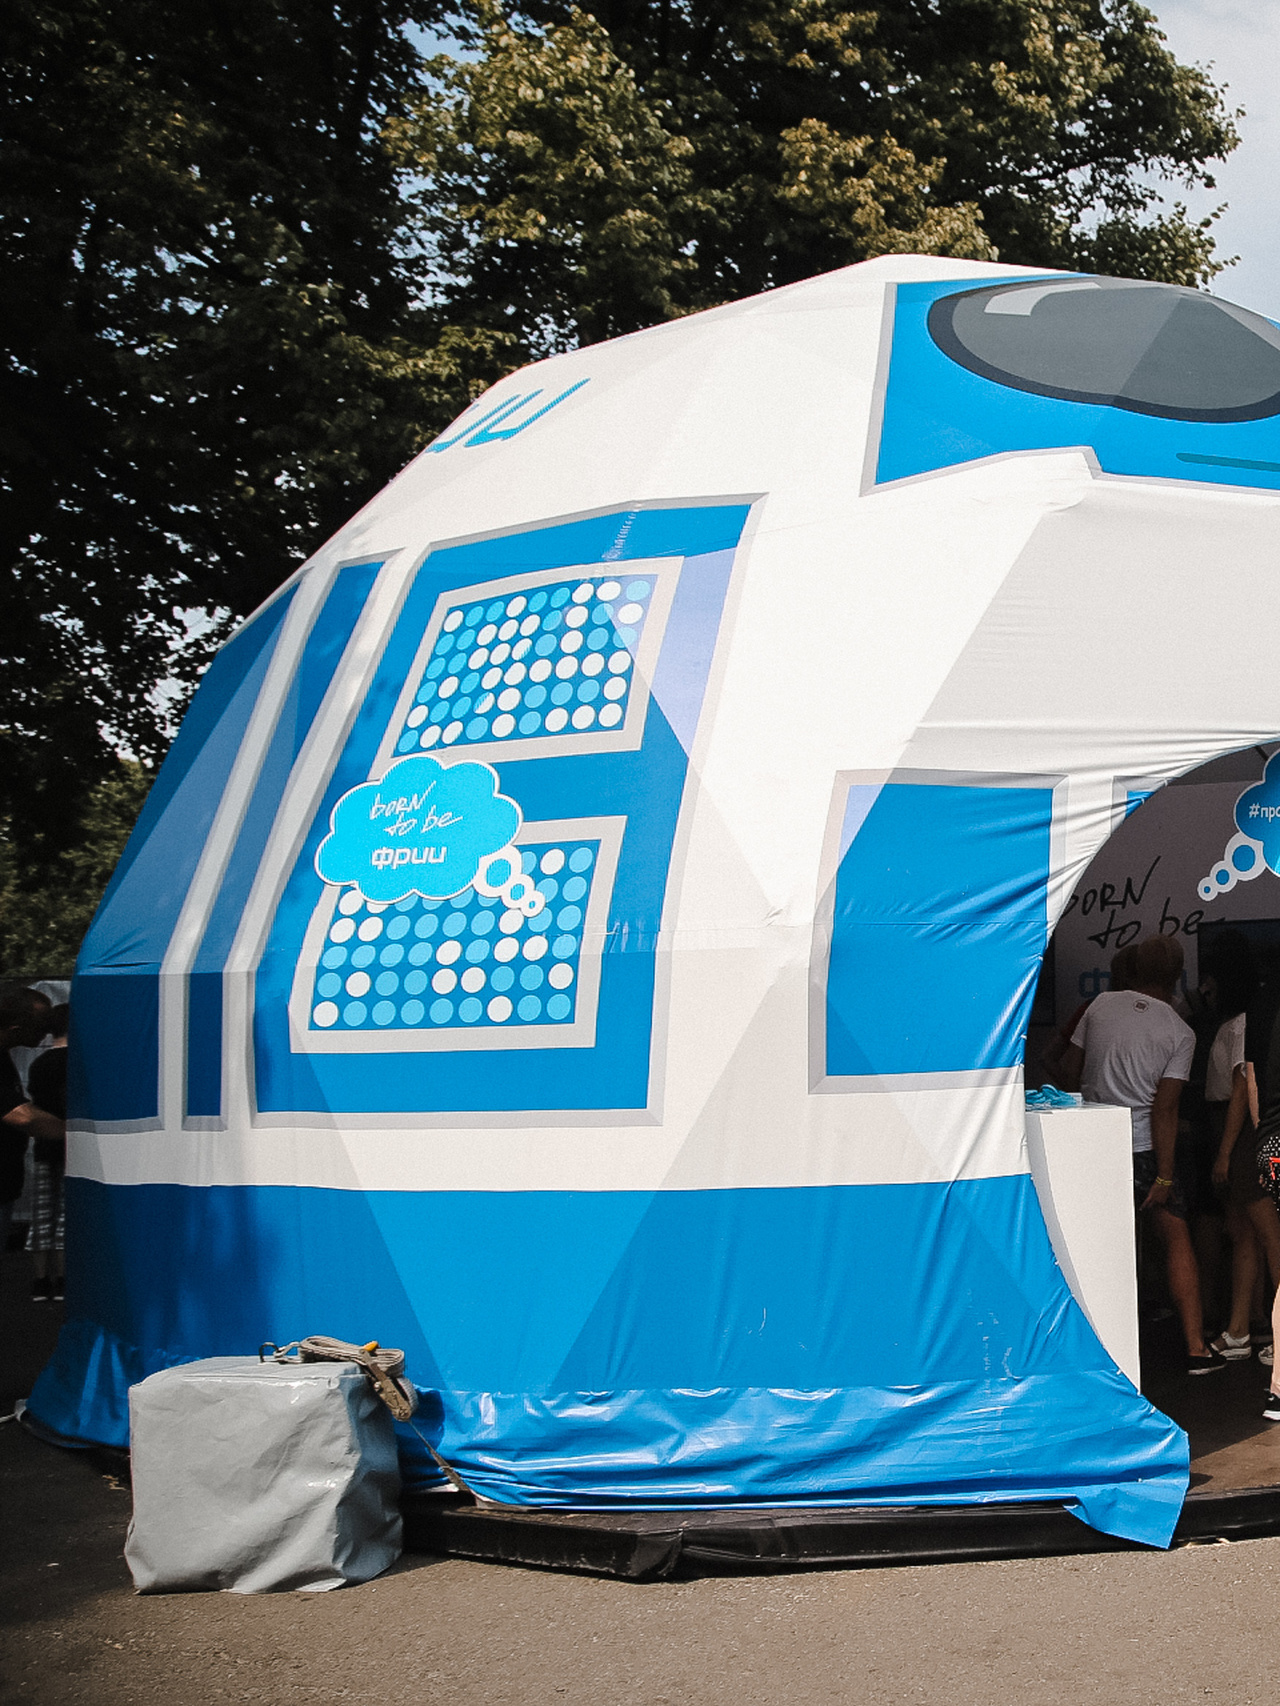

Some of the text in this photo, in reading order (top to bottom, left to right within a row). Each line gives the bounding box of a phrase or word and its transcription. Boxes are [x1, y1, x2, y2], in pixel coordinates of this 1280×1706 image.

[383, 804, 464, 836] to be
[1087, 897, 1226, 949] to be
